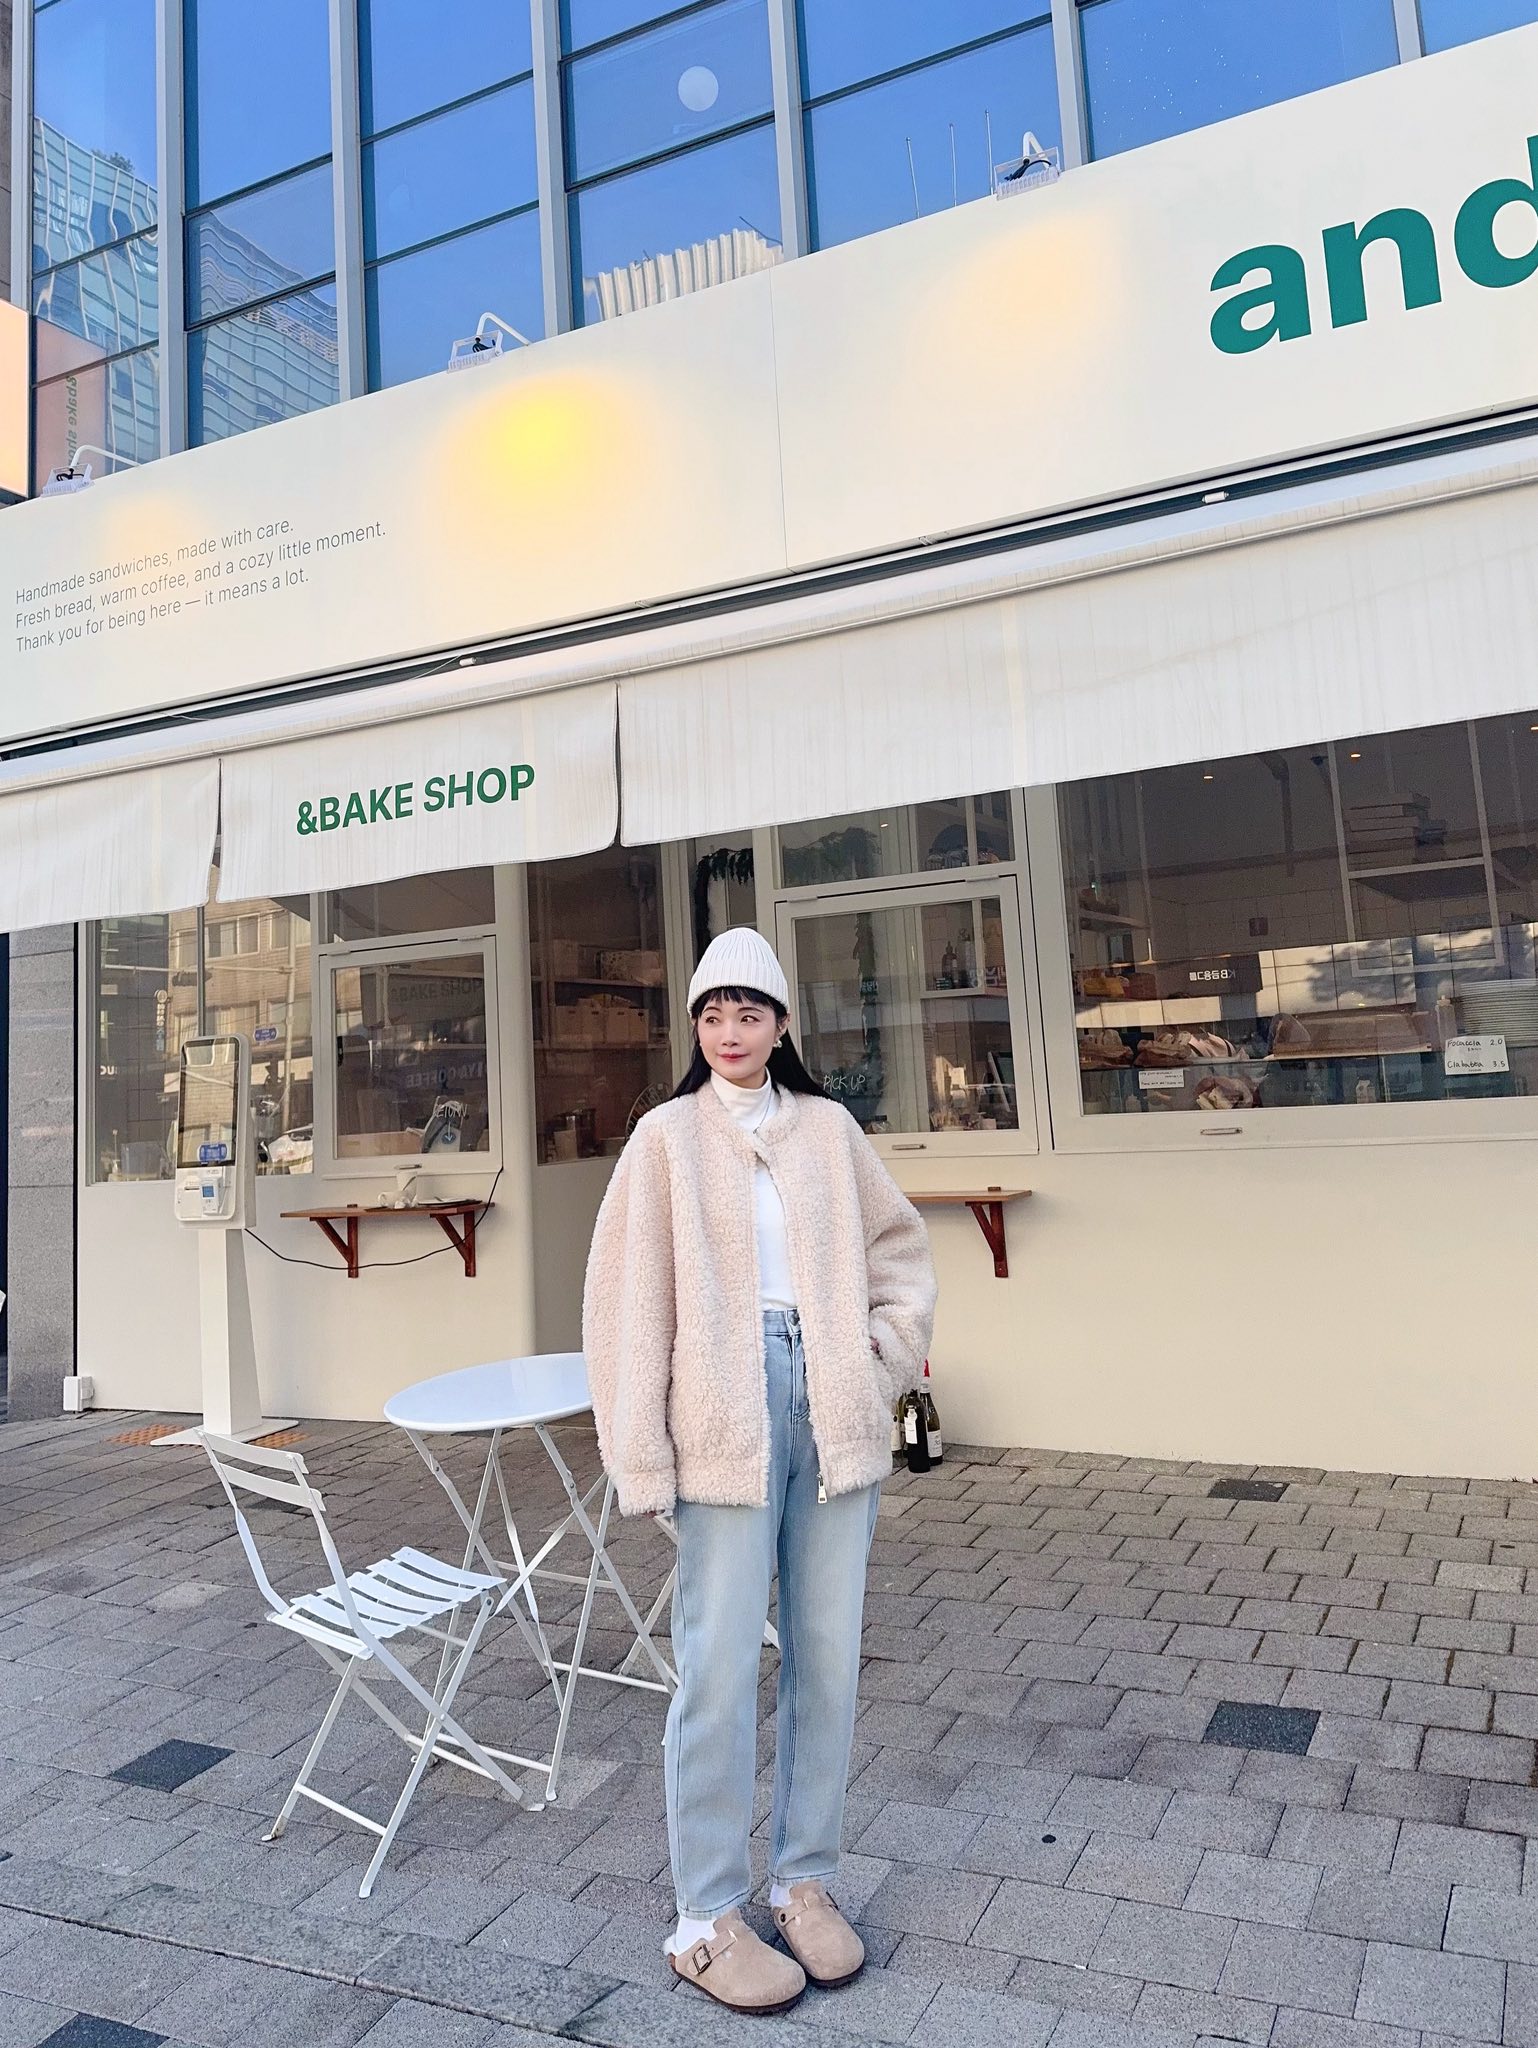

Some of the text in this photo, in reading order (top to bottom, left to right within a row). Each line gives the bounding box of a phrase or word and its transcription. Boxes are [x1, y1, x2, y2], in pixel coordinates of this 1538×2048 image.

[1210, 134, 1538, 354] and
[16, 519, 294, 604] Handmade sandwiches, made with care.
[16, 520, 387, 629] Fresh bread, warm coffee, and a cozy little moment.
[17, 630, 55, 653] Thank
[58, 625, 82, 647] you
[86, 614, 104, 635] for
[108, 604, 146, 630] being
[150, 598, 181, 620] here
[205, 589, 214, 606] it
[218, 579, 268, 604] means
[271, 575, 281, 589] a
[285, 567, 309, 586] lot.
[296, 764, 535, 836] &BAKE SHOP
[823, 1073, 866, 1092] PICK UP
